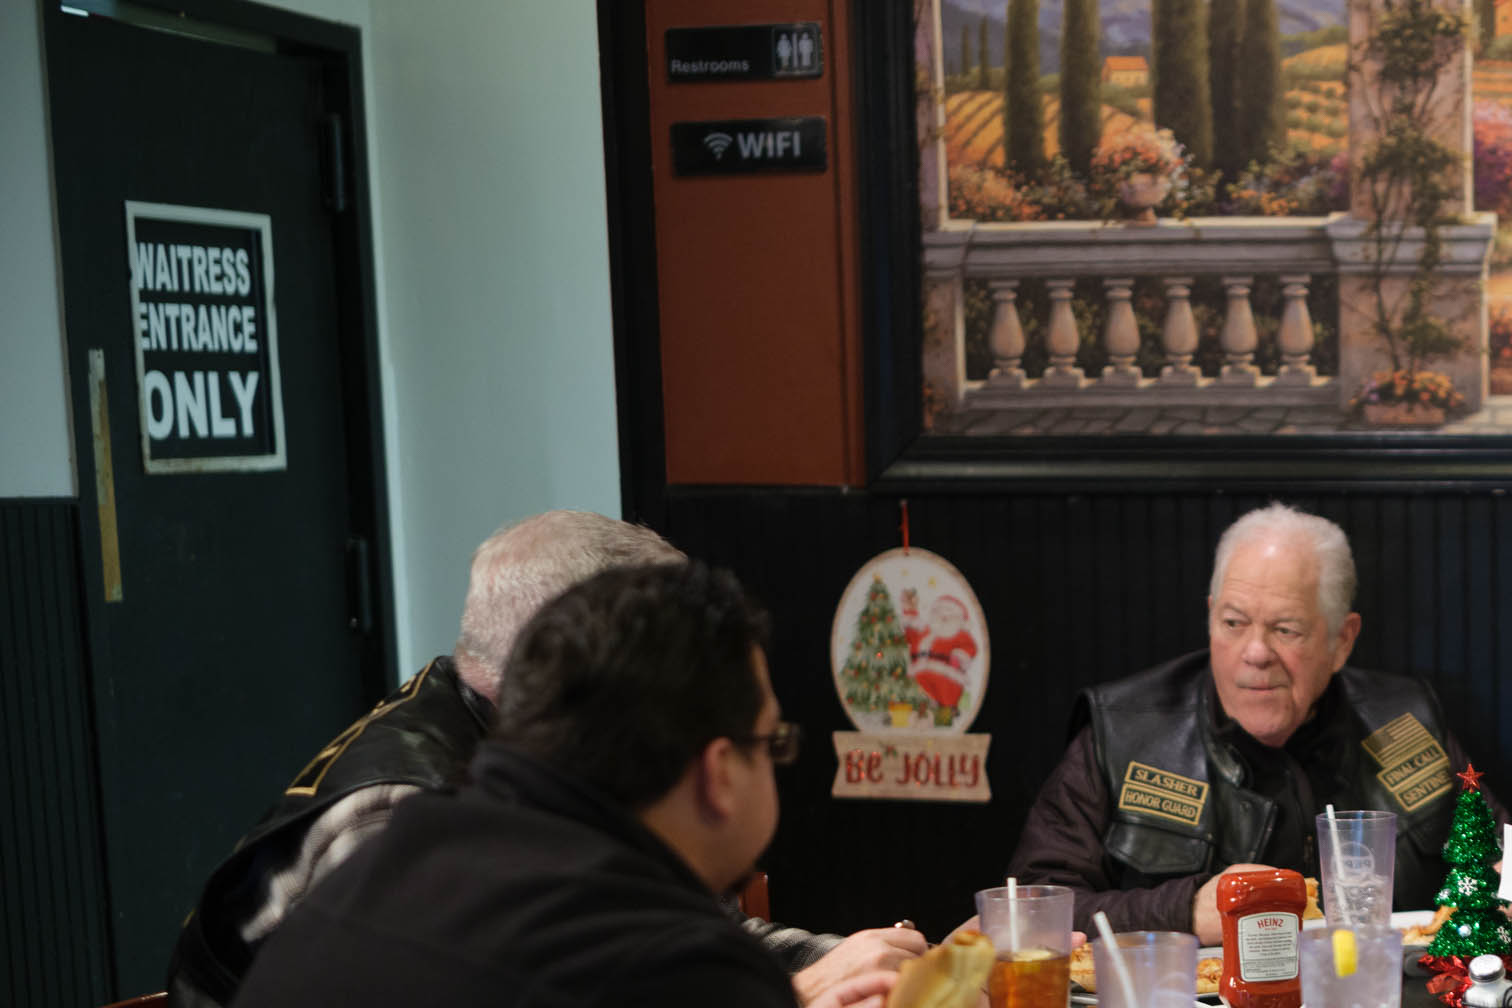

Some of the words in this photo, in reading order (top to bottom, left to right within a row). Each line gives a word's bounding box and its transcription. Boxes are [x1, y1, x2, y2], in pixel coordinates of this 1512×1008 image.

[671, 59, 750, 73] Restrooms
[737, 130, 801, 159] WIFI
[135, 242, 251, 297] WAITRESS
[139, 302, 258, 354] ENTRANCE
[144, 369, 260, 441] ONLY
[1134, 768, 1199, 797] SLASHER
[1384, 761, 1417, 785] FINAL
[1125, 790, 1161, 809] HONOR
[1161, 799, 1197, 818] GUARD
[1256, 918, 1284, 929] HEINZ
